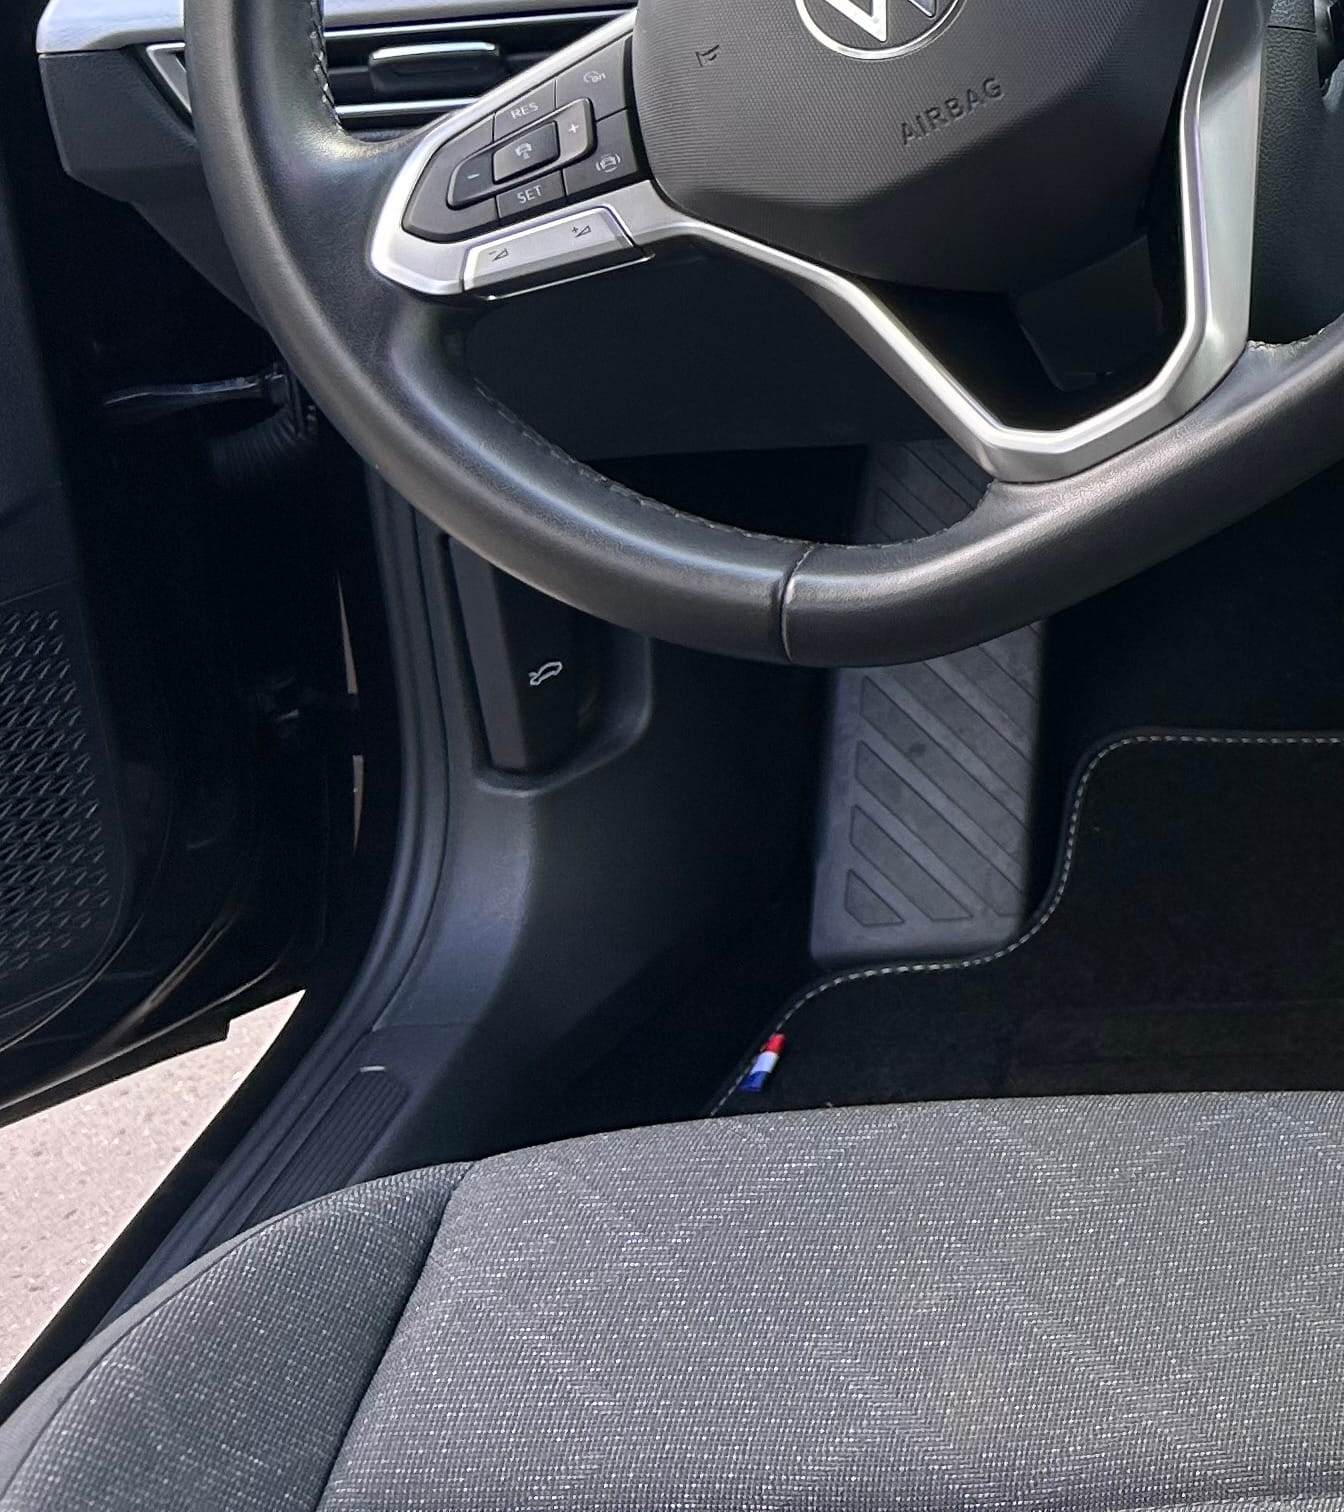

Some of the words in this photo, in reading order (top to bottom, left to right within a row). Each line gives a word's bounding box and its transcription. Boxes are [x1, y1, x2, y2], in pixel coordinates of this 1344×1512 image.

[510, 101, 539, 120] RES
[901, 77, 1004, 147] AIRBAG
[517, 184, 543, 204] SET
